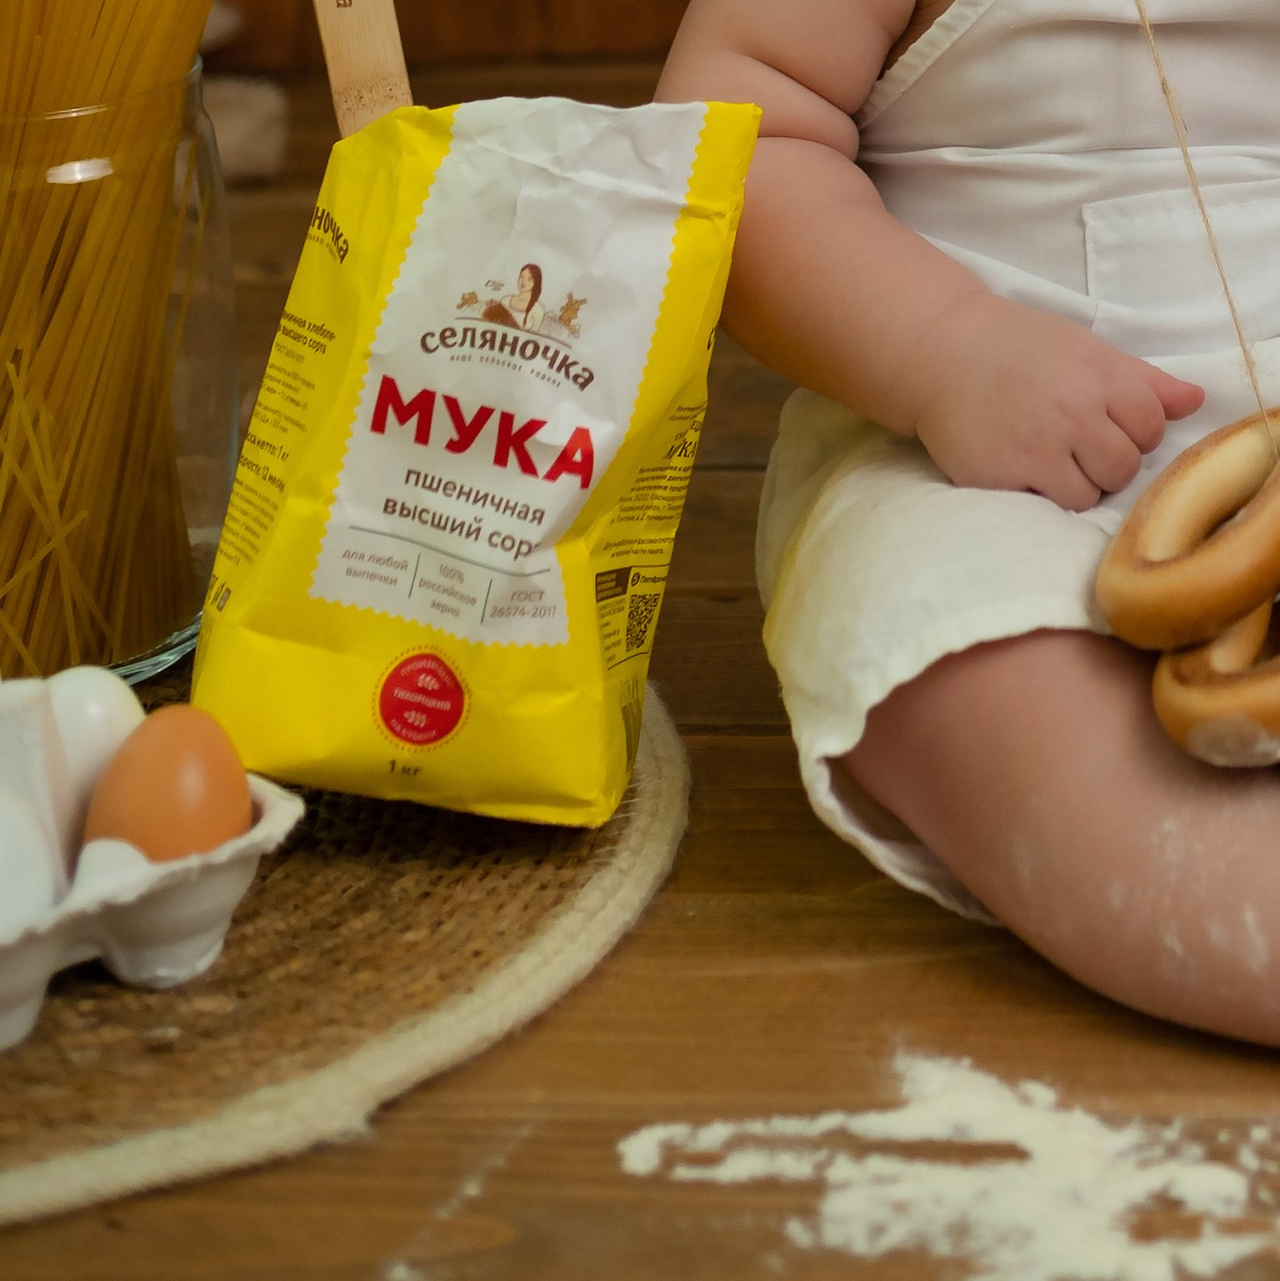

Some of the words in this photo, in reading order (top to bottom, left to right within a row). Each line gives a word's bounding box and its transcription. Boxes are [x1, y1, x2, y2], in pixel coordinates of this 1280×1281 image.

[369, 374, 595, 491] МУКА
[403, 468, 546, 527] пшеничная
[381, 497, 483, 543] высший
[342, 547, 365, 562] для
[368, 553, 408, 572] любой
[345, 566, 399, 587] выпечки
[439, 563, 466, 585] 100%
[510, 589, 546, 603] ГОСТ
[389, 758, 396, 774] 1
